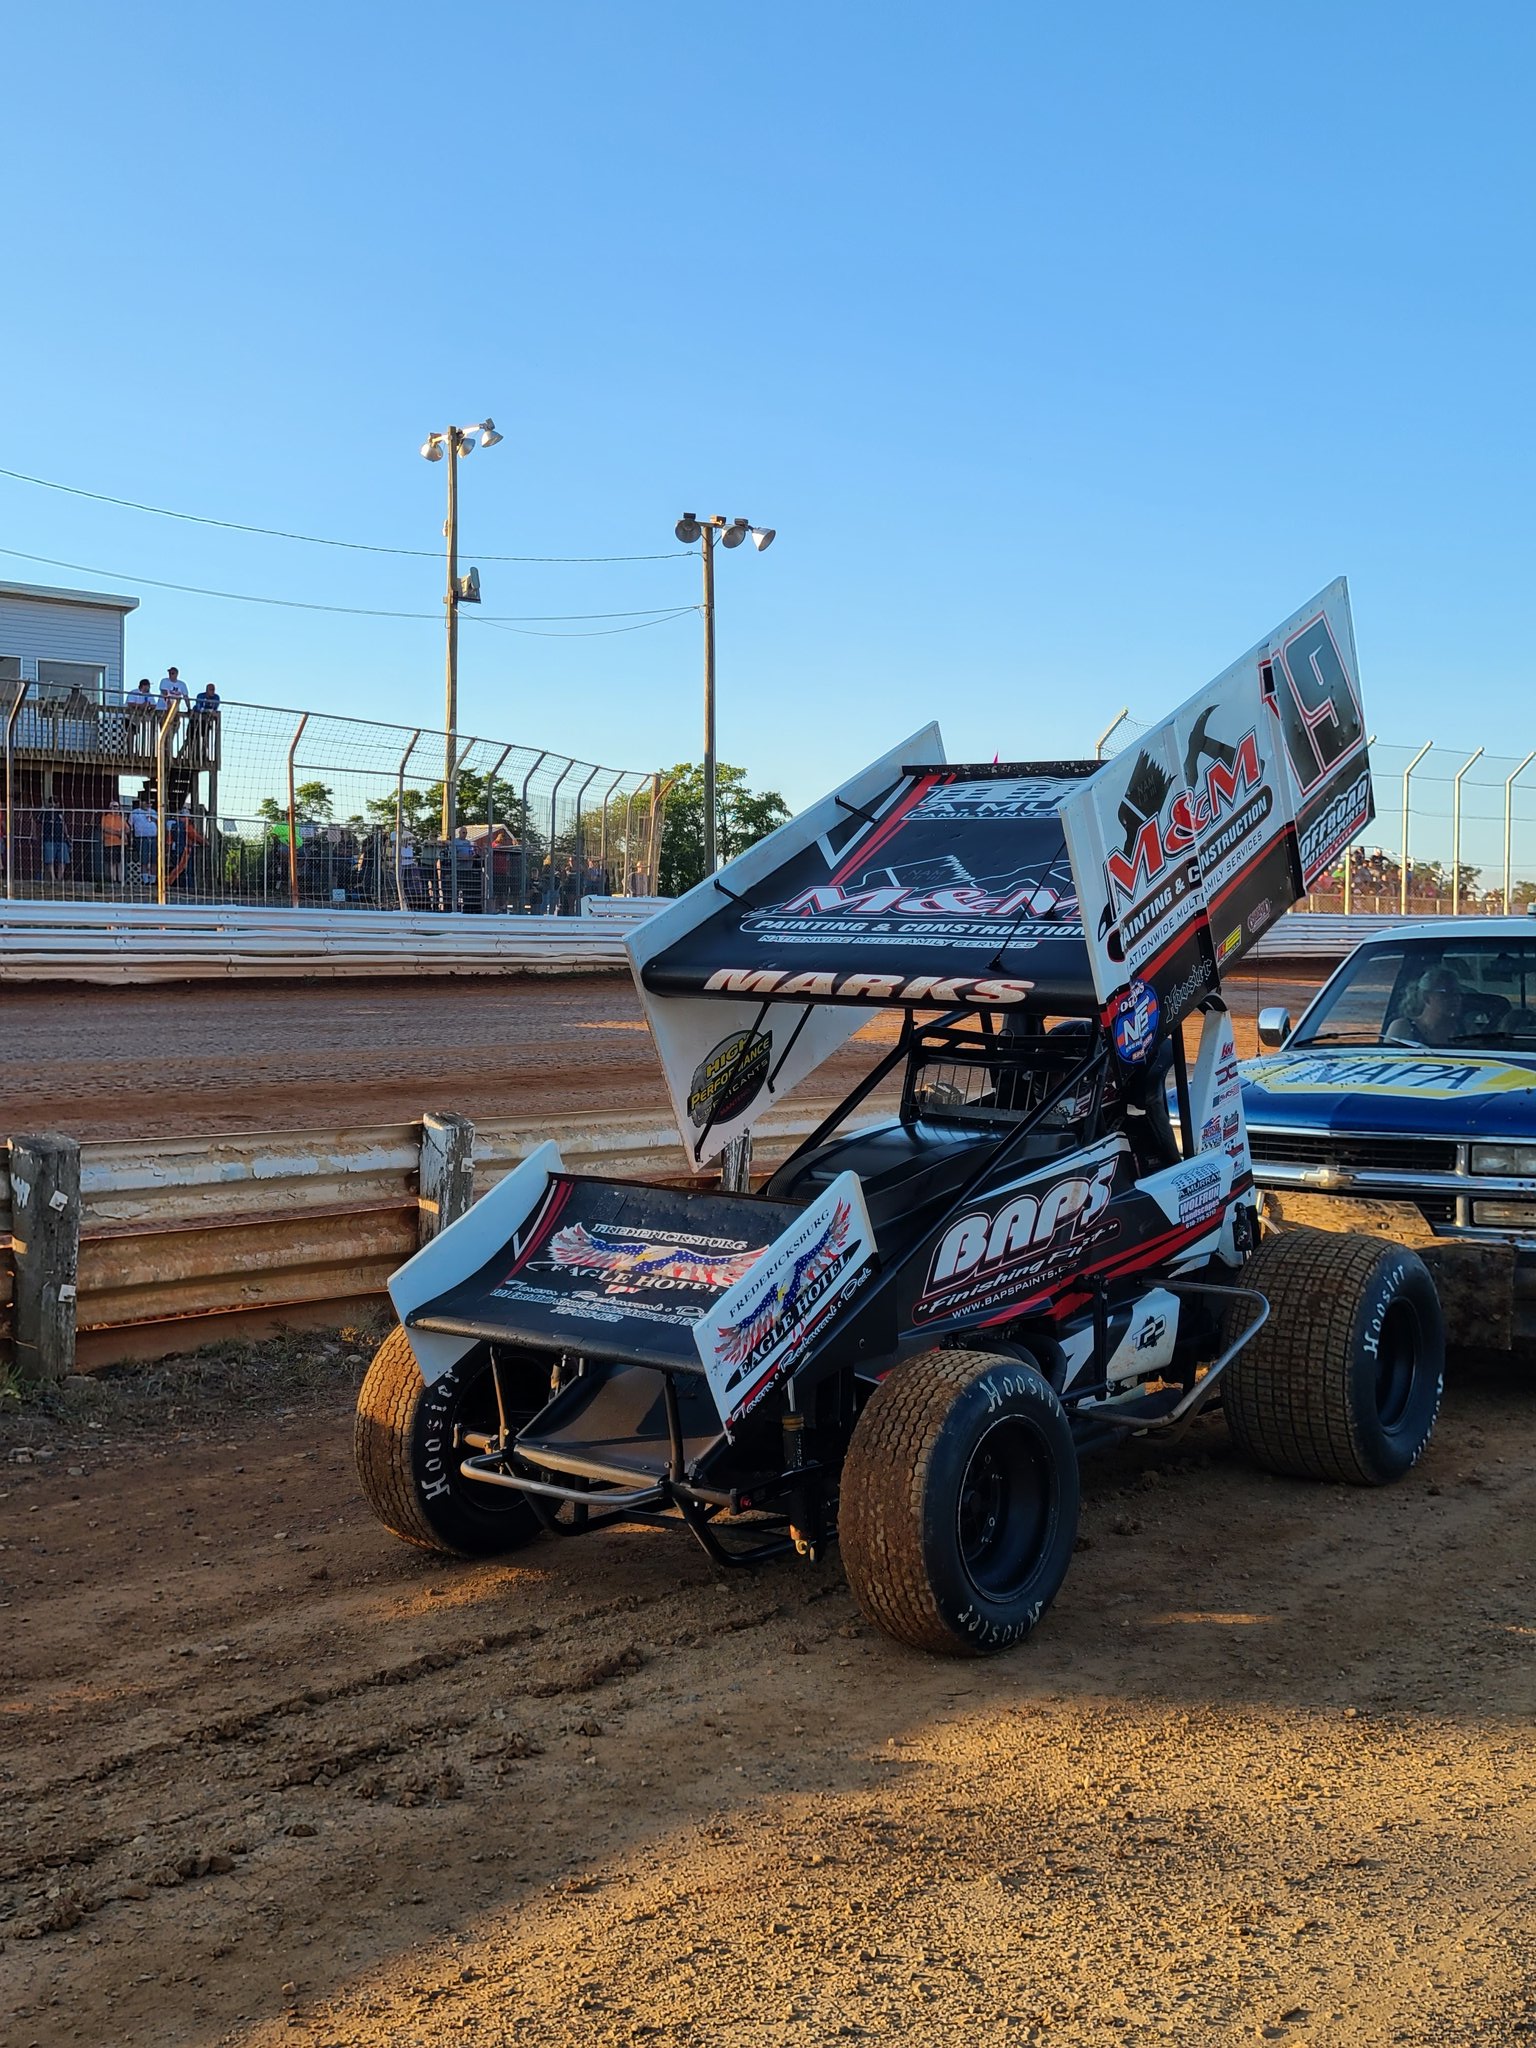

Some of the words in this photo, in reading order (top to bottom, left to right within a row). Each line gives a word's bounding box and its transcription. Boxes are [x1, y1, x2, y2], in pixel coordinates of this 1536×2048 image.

[1259, 610, 1364, 797] 19
[1103, 733, 1261, 905] M&M
[1301, 779, 1368, 860] OFFROAD
[754, 920, 869, 932] PAINTING
[871, 923, 892, 932] &
[898, 923, 1086, 936] CONSTRUCTION
[776, 886, 1080, 915] M&M
[1121, 886, 1173, 945] AINTING
[1175, 877, 1186, 896] &
[1126, 918, 1175, 973] ATIONWIDE
[1226, 831, 1264, 873] SERVICES
[758, 934, 853, 944] NATIONWIDE
[853, 937, 953, 946] MULTIFAMILY
[953, 939, 1039, 949] SERVICES
[703, 968, 1035, 1003] MARKS
[1285, 1062, 1482, 1090] NAPA
[591, 1223, 748, 1250] FREDERICKSBURG
[729, 1209, 830, 1318] FREDERICKSBURG
[923, 1156, 1118, 1297] BAPS
[738, 1311, 795, 1380] EAGLE
[796, 1251, 851, 1317] HOTEL
[1362, 1264, 1406, 1360] Hoosier
[731, 1379, 776, 1422] Tavern
